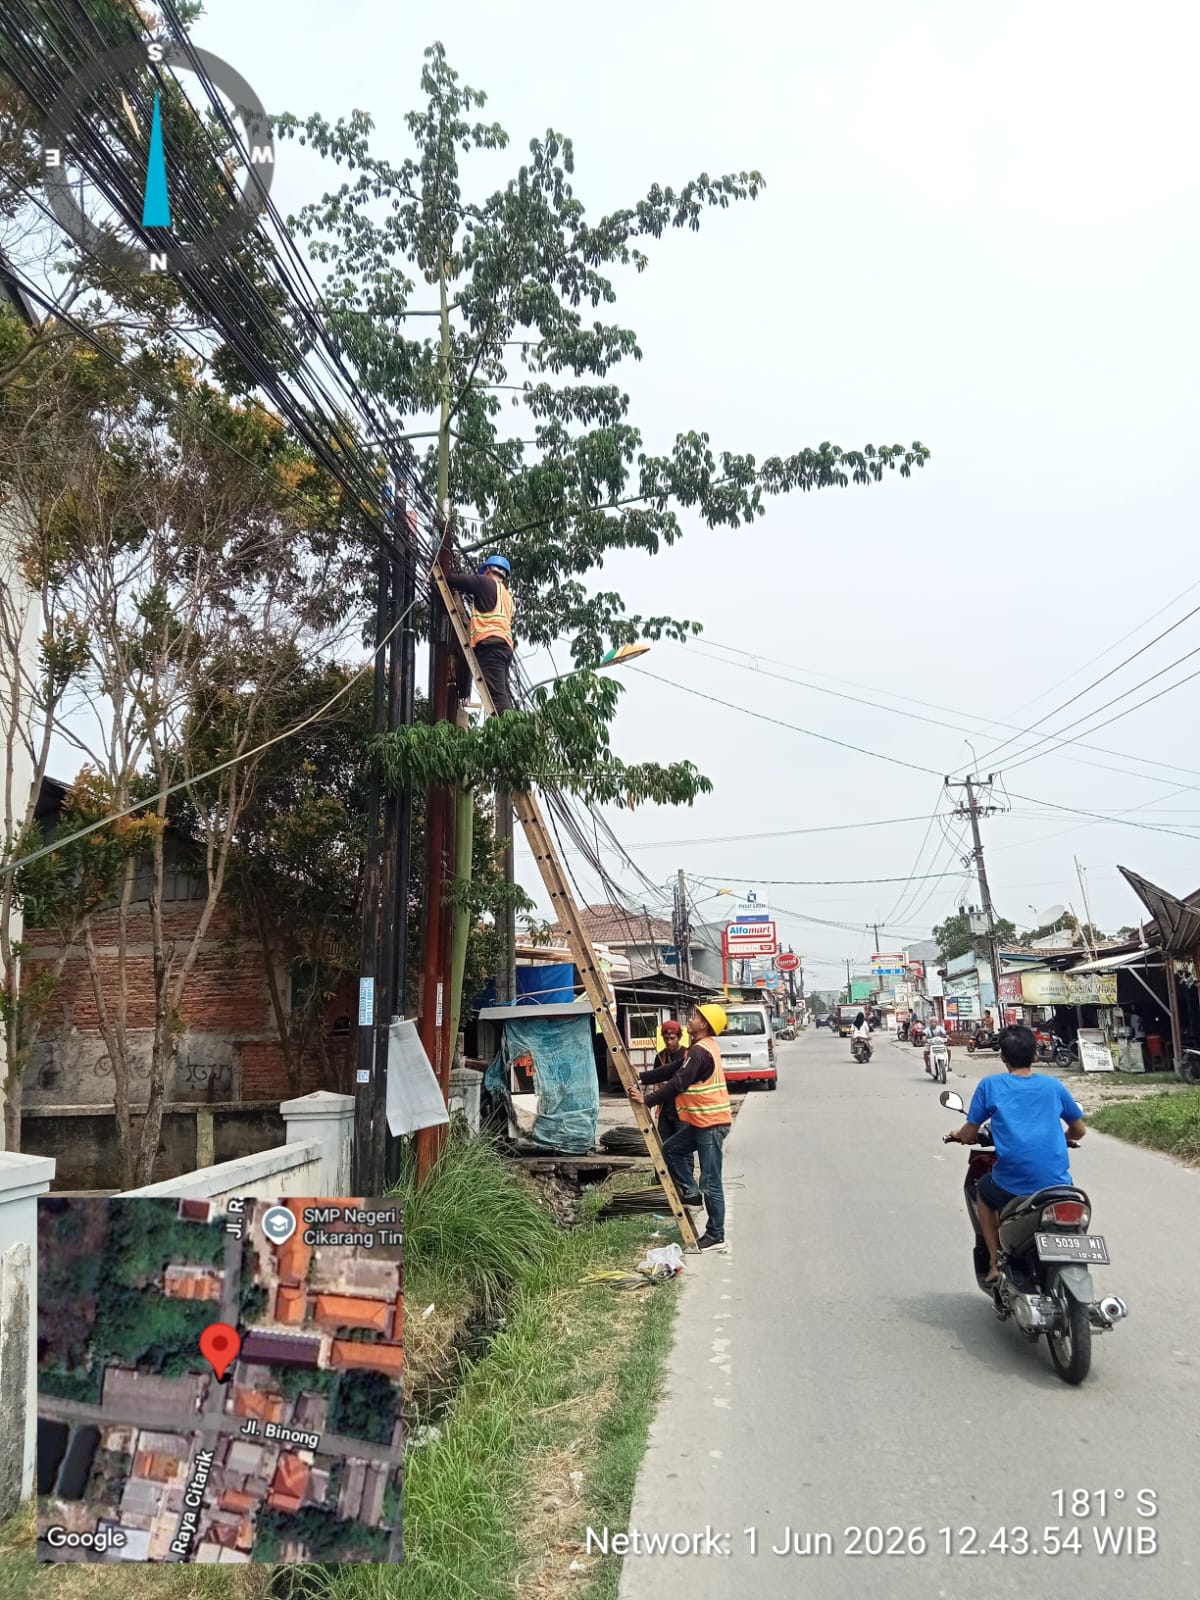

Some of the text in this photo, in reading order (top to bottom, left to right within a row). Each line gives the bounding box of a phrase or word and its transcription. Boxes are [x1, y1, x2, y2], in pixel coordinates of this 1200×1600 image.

[730, 926, 771, 934] Alfamart
[1040, 1237, 1048, 1247] E
[1055, 1238, 1080, 1248] 5039
